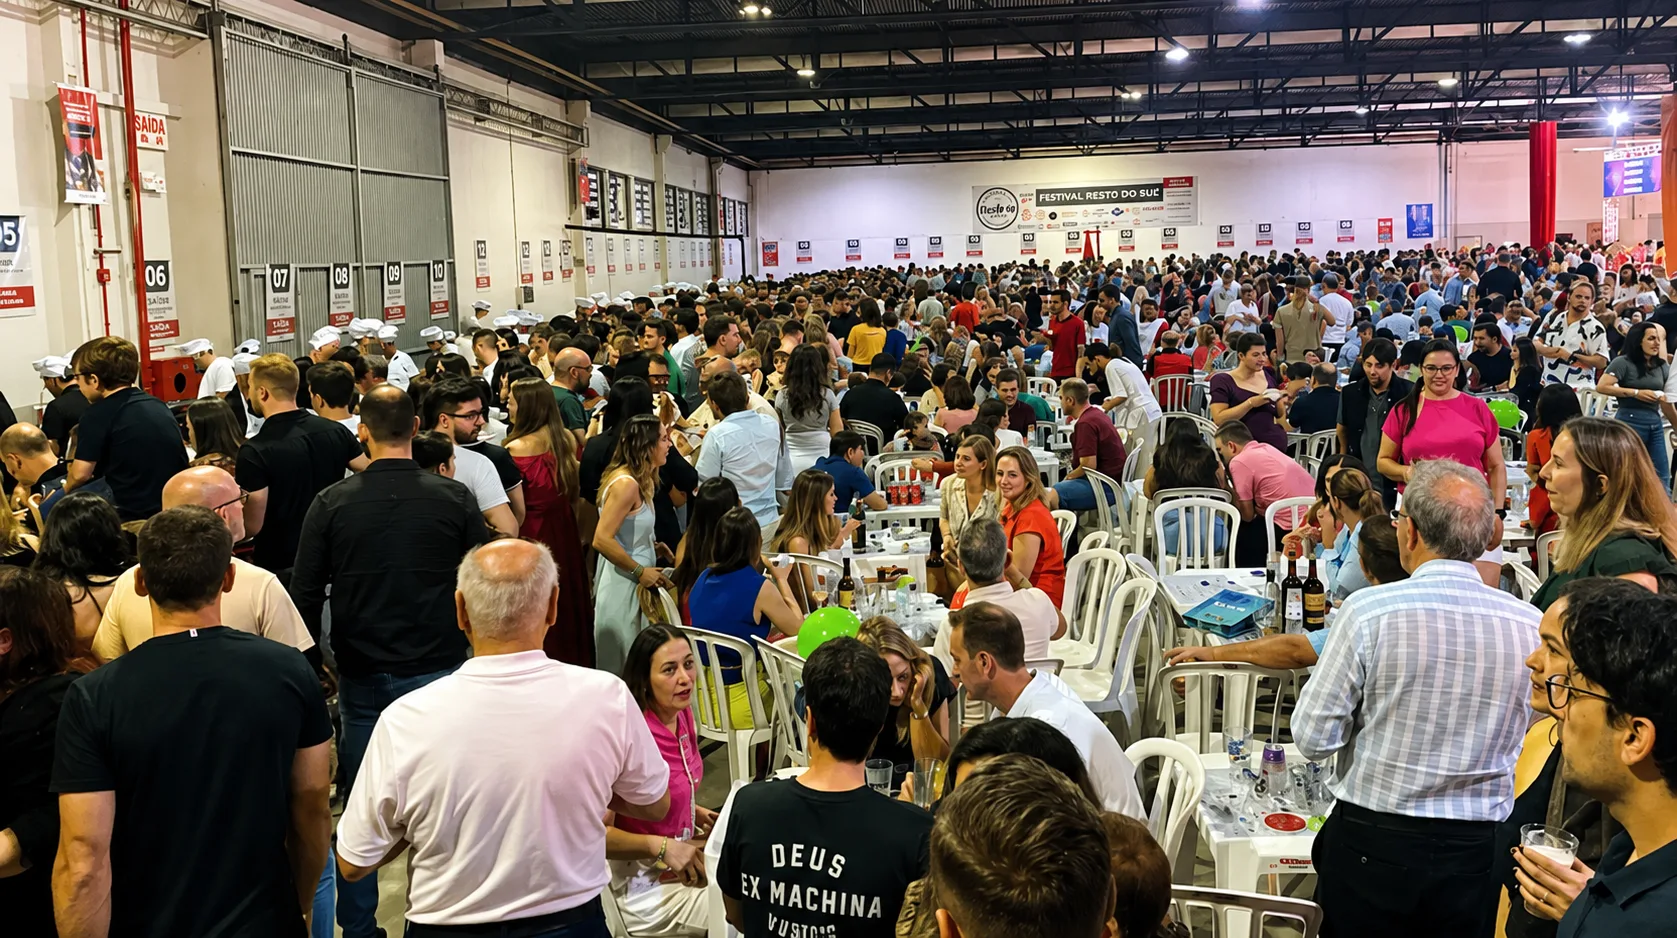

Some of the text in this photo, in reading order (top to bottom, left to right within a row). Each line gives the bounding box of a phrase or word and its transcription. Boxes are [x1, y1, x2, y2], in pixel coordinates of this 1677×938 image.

[1039, 191, 1084, 202] FESTIVAL
[1085, 190, 1119, 200] RESTO
[1121, 189, 1137, 198] DO
[0, 221, 16, 246] 5
[145, 265, 166, 287] 06
[273, 268, 288, 288] 07
[335, 267, 348, 285] 08
[388, 265, 400, 281] 09
[434, 263, 443, 279] 10
[771, 843, 846, 878] DEUS
[741, 873, 882, 919] EX MACHINA
